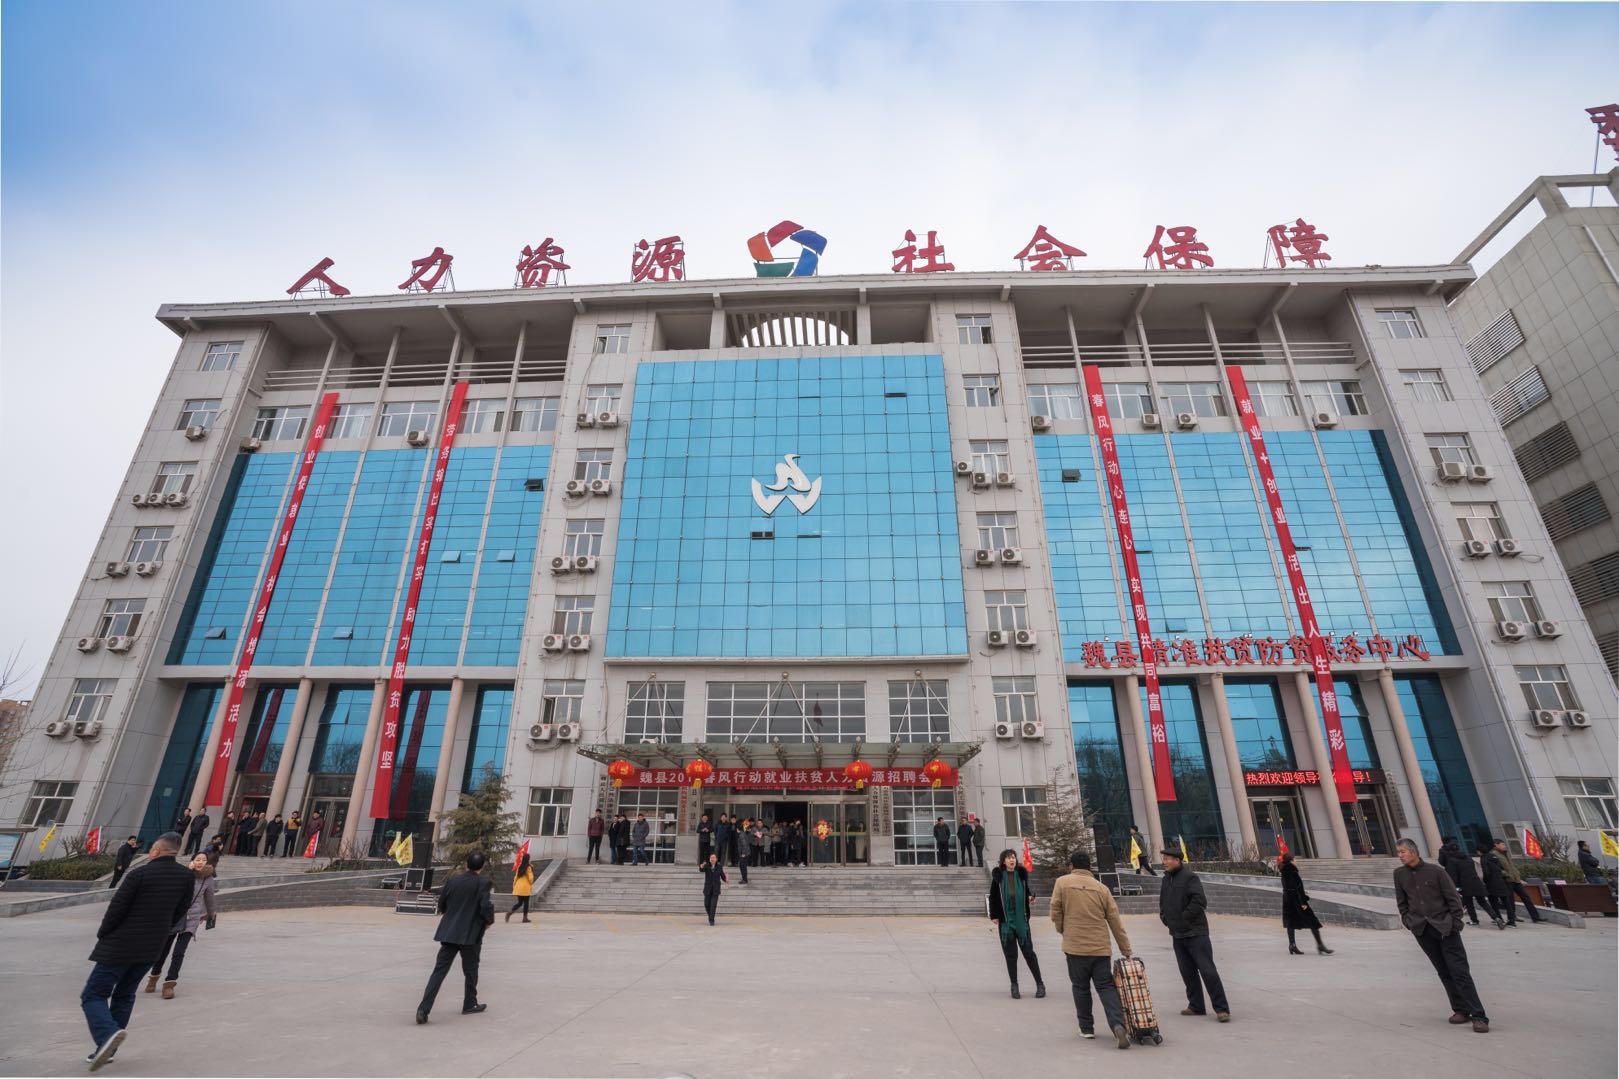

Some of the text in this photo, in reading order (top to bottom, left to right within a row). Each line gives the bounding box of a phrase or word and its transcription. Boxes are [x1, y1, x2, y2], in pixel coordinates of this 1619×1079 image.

[287, 219, 1332, 296] 人力资源 社会保障
[1091, 393, 1134, 551] 春风行动心连心
[379, 606, 415, 770] 助力脱贫攻坚
[1287, 552, 1346, 751] 活出人生精彩
